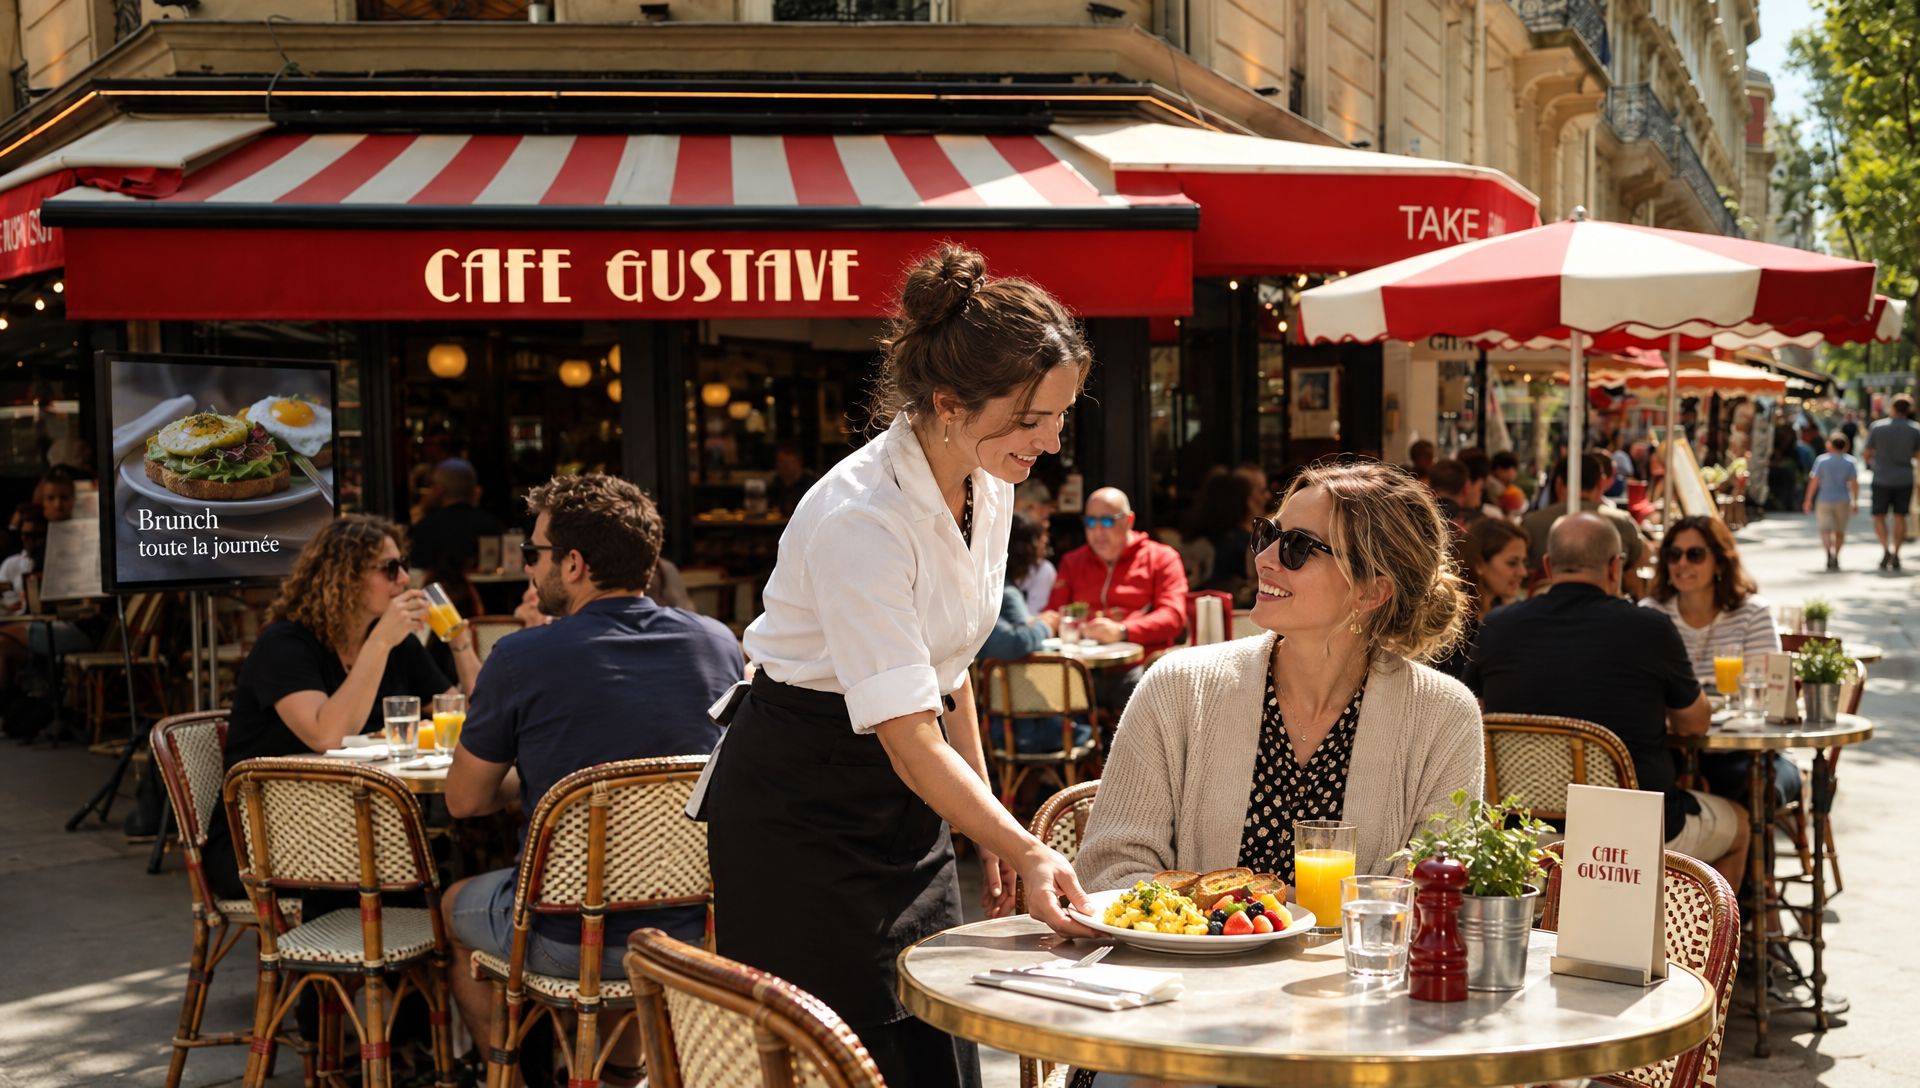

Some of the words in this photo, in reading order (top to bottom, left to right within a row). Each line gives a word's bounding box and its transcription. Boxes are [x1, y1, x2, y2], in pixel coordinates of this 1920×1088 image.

[1398, 205, 1481, 243] TAKE
[424, 248, 572, 303] CAFE
[605, 248, 860, 303] GUSTAVE
[138, 507, 219, 531] Brunch
[139, 540, 188, 557] toute
[192, 536, 208, 556] la
[211, 535, 280, 560] journée
[1592, 846, 1629, 865] CAFE
[1577, 862, 1641, 885] GUSTAVE
